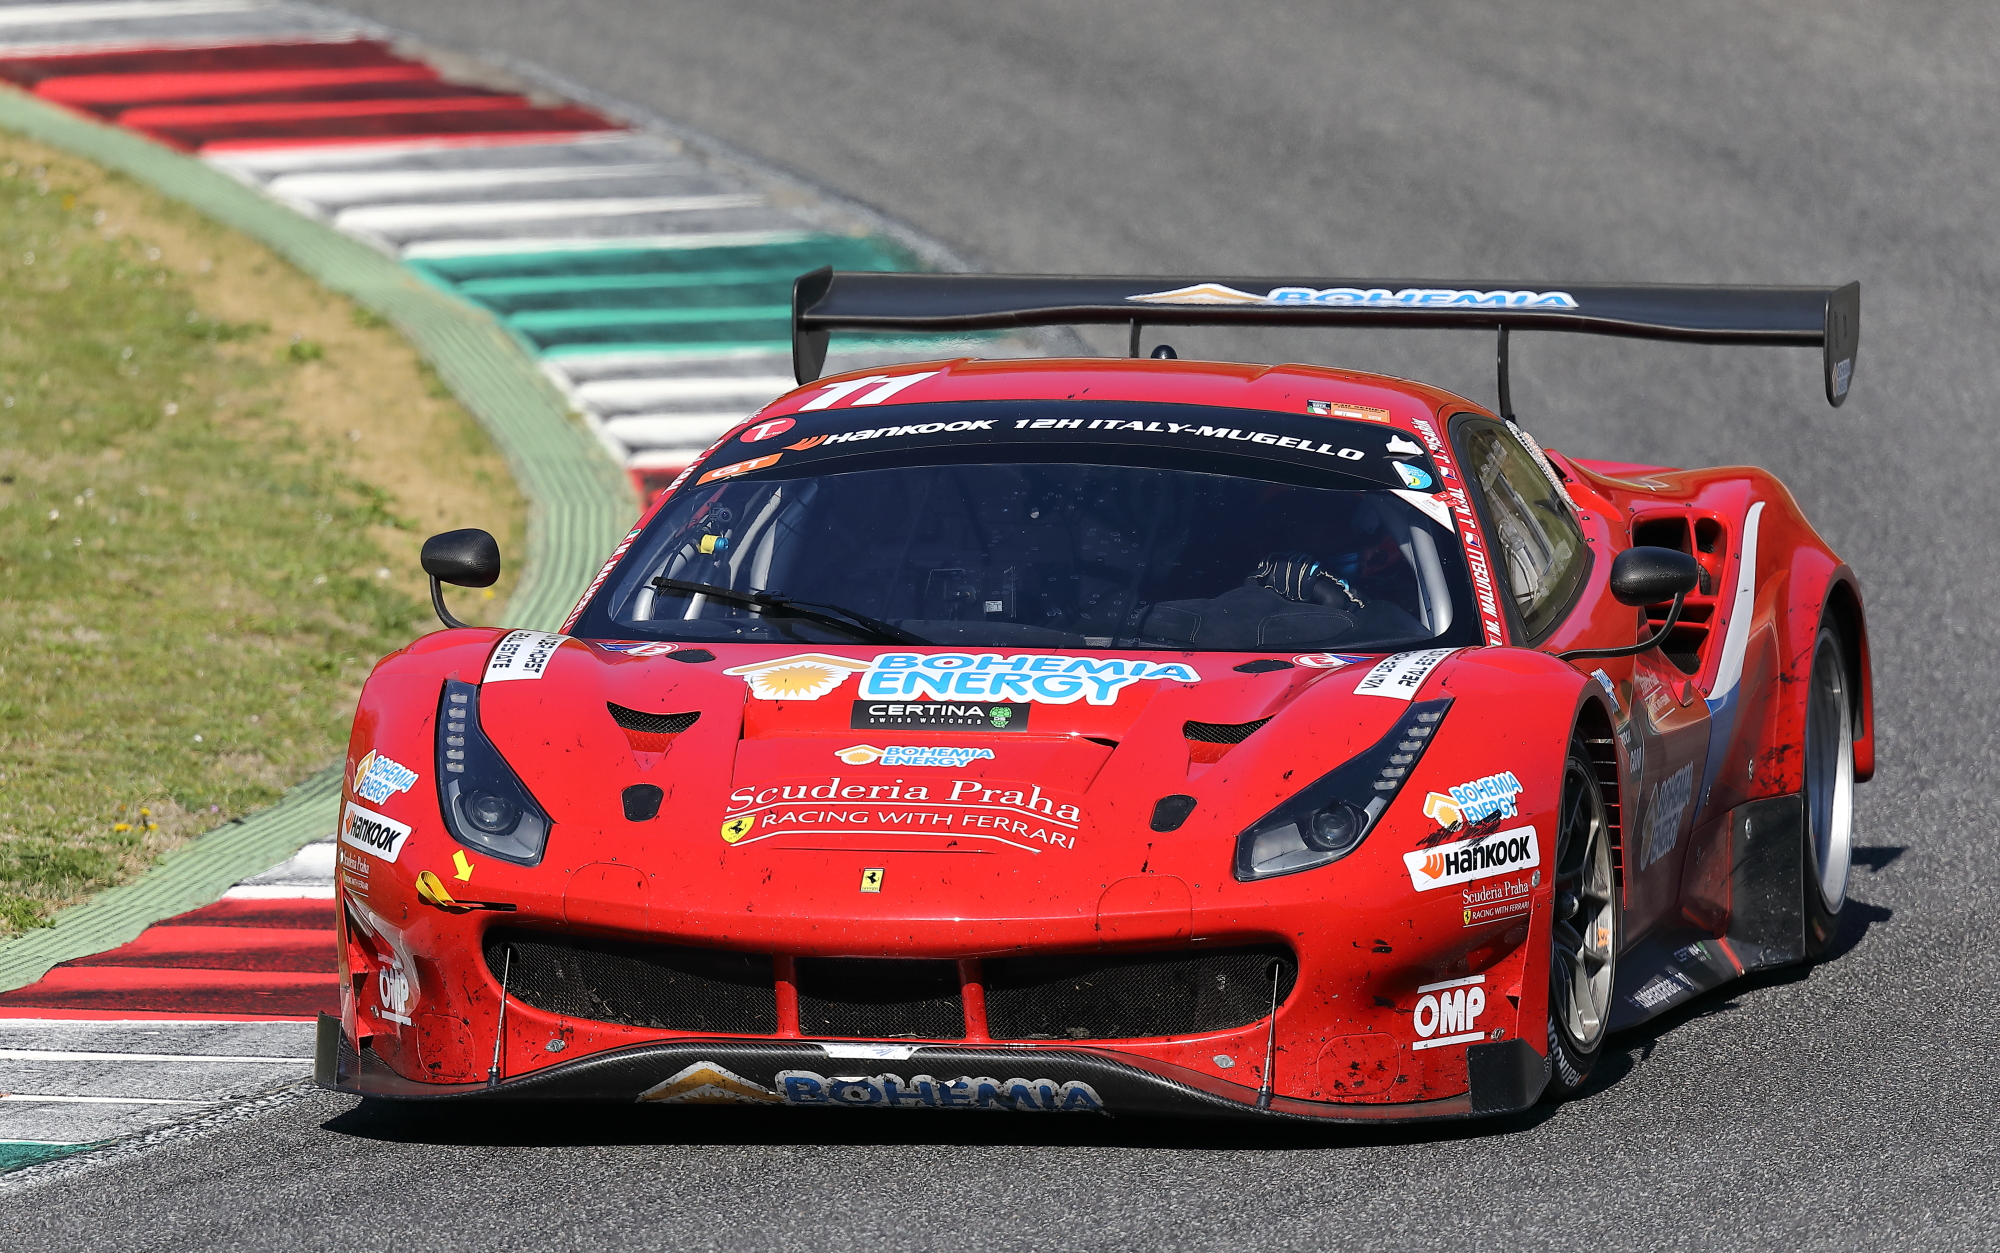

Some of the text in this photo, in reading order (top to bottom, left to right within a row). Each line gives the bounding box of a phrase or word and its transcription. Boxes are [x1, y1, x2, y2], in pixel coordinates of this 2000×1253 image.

[1273, 291, 1569, 308] BOHEMIA
[797, 371, 942, 412] 11
[1013, 417, 1086, 430] 12H
[1086, 418, 1367, 462] ITALY-MUGELLO
[711, 456, 770, 478] GT
[1466, 547, 1502, 638] M. MALUCELLI
[876, 654, 1193, 682] BOHEMIA
[866, 671, 1132, 701] ENERGY
[868, 704, 986, 717] CERTINA
[919, 717, 983, 725] WATCHES
[882, 755, 971, 766] ENERGY
[886, 746, 993, 759] BOHEMIA
[360, 775, 395, 803] ENERGY
[369, 757, 416, 791] BOHEMIA
[1452, 771, 1521, 806] BOHEMIA
[726, 777, 1082, 823] Scuderia Praha
[760, 810, 1076, 850] RACING WITH FERRARI
[1462, 877, 1530, 905] Scuderia Praha
[1472, 907, 1495, 920] RACING
[1494, 904, 1509, 915] WITH
[379, 967, 410, 1014] OMP
[1412, 985, 1487, 1039] OMP
[784, 1074, 1102, 1110] BOHEMIA
